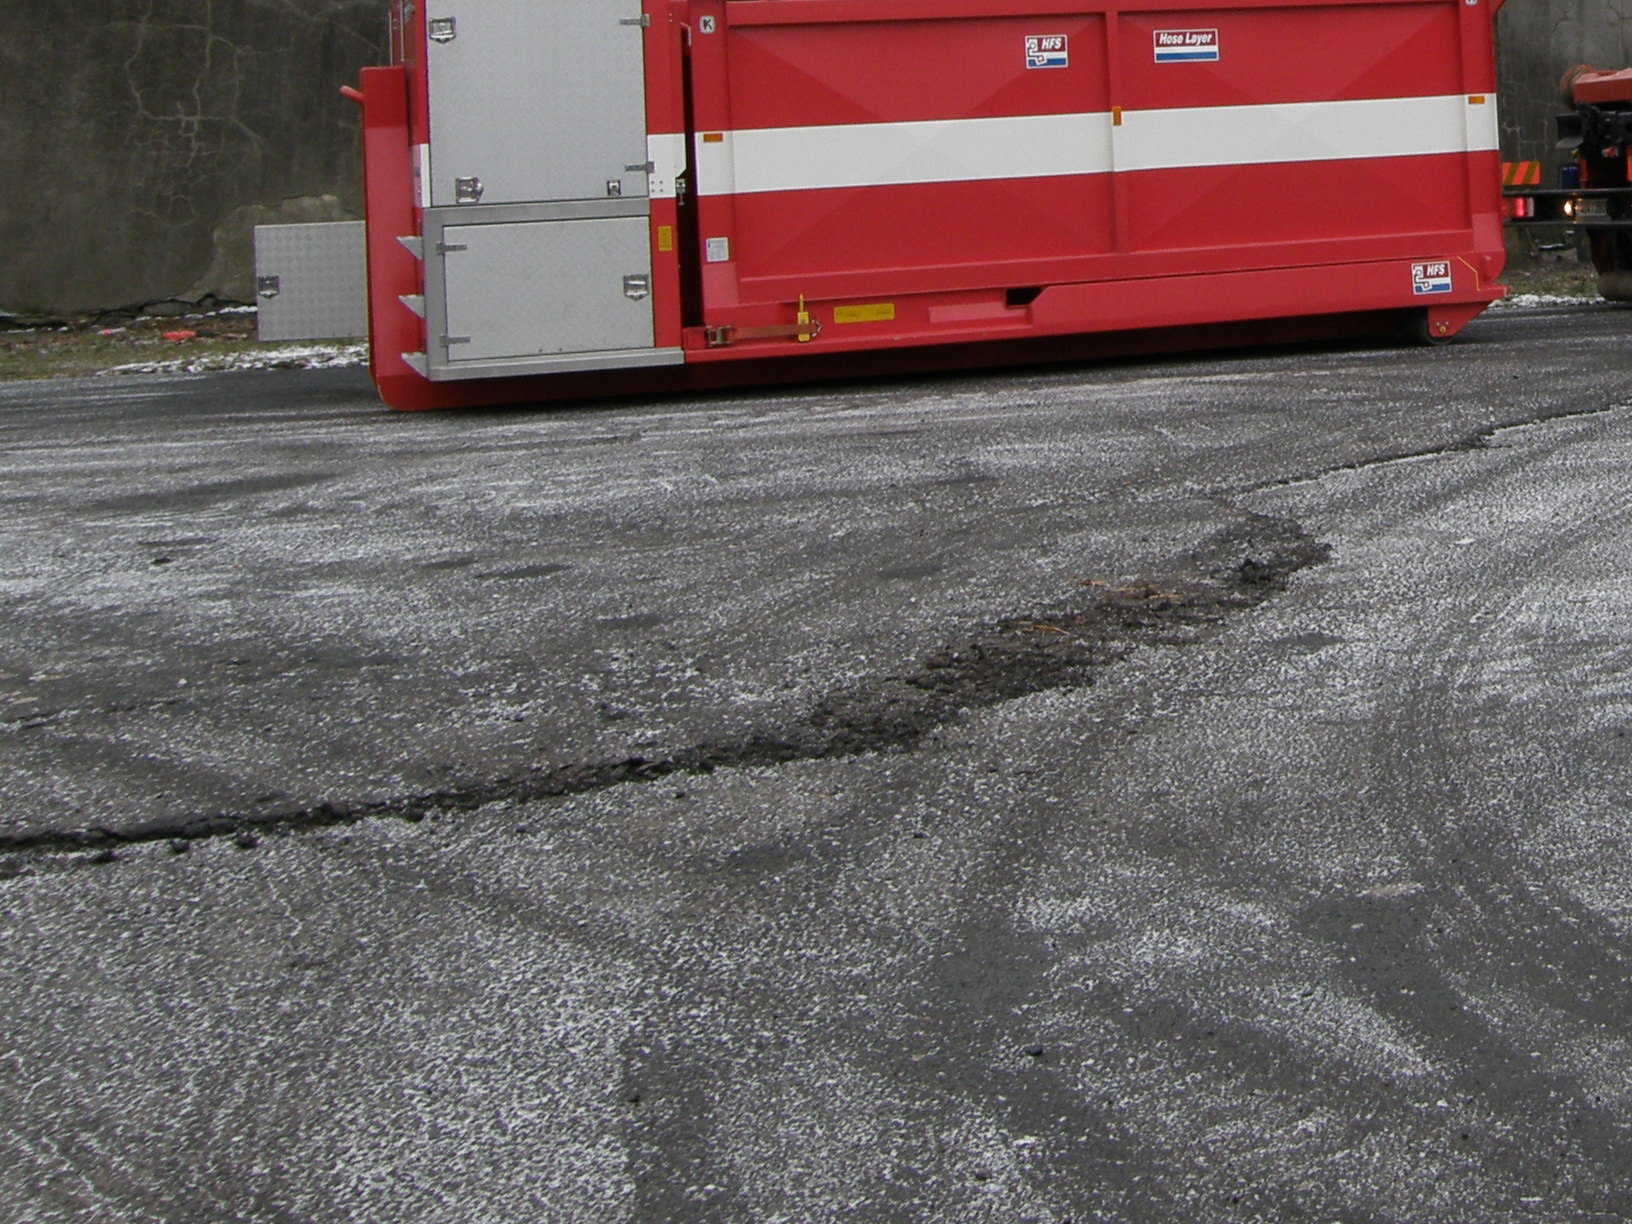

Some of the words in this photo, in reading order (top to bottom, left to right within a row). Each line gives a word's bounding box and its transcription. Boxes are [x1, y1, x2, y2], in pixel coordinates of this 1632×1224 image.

[702, 18, 712, 30] K
[1041, 37, 1062, 50] HFS
[1159, 32, 1183, 45] Hose
[1185, 32, 1213, 46] Layer
[1426, 263, 1446, 276] HFS
